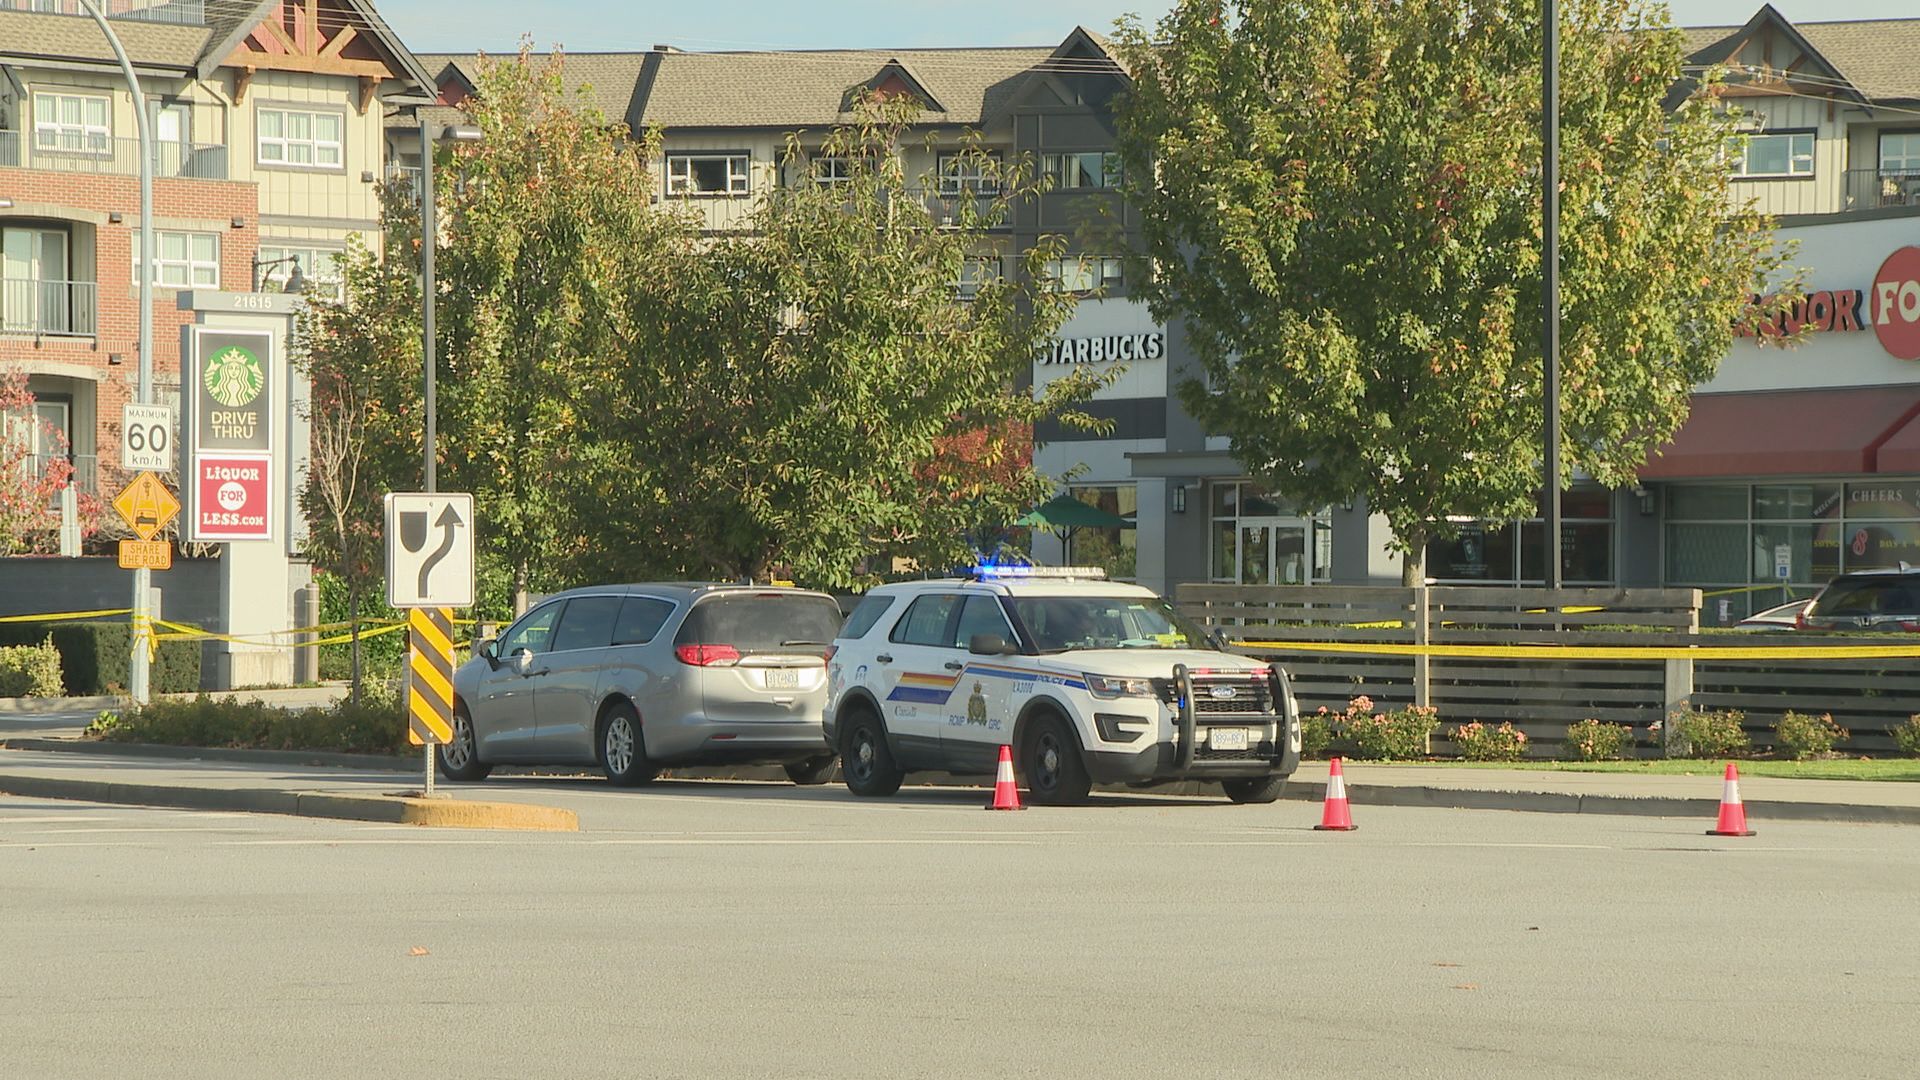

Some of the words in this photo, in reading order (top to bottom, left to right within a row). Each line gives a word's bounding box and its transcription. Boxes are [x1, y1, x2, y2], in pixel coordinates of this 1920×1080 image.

[233, 295, 272, 309] 21615
[1731, 290, 1862, 337] QUOR
[128, 410, 167, 419] MAXIMUM
[211, 411, 257, 425] DRIVE
[128, 423, 167, 452] 60
[212, 425, 253, 439] THRU
[132, 454, 162, 465] km/h
[220, 490, 244, 501] FOR
[1851, 489, 1903, 502] CHEERS
[1852, 528, 1869, 556] 8
[130, 544, 160, 554] SHARE
[123, 555, 139, 564] THE
[142, 555, 167, 565] ROAD
[1036, 674, 1065, 685] POLICE
